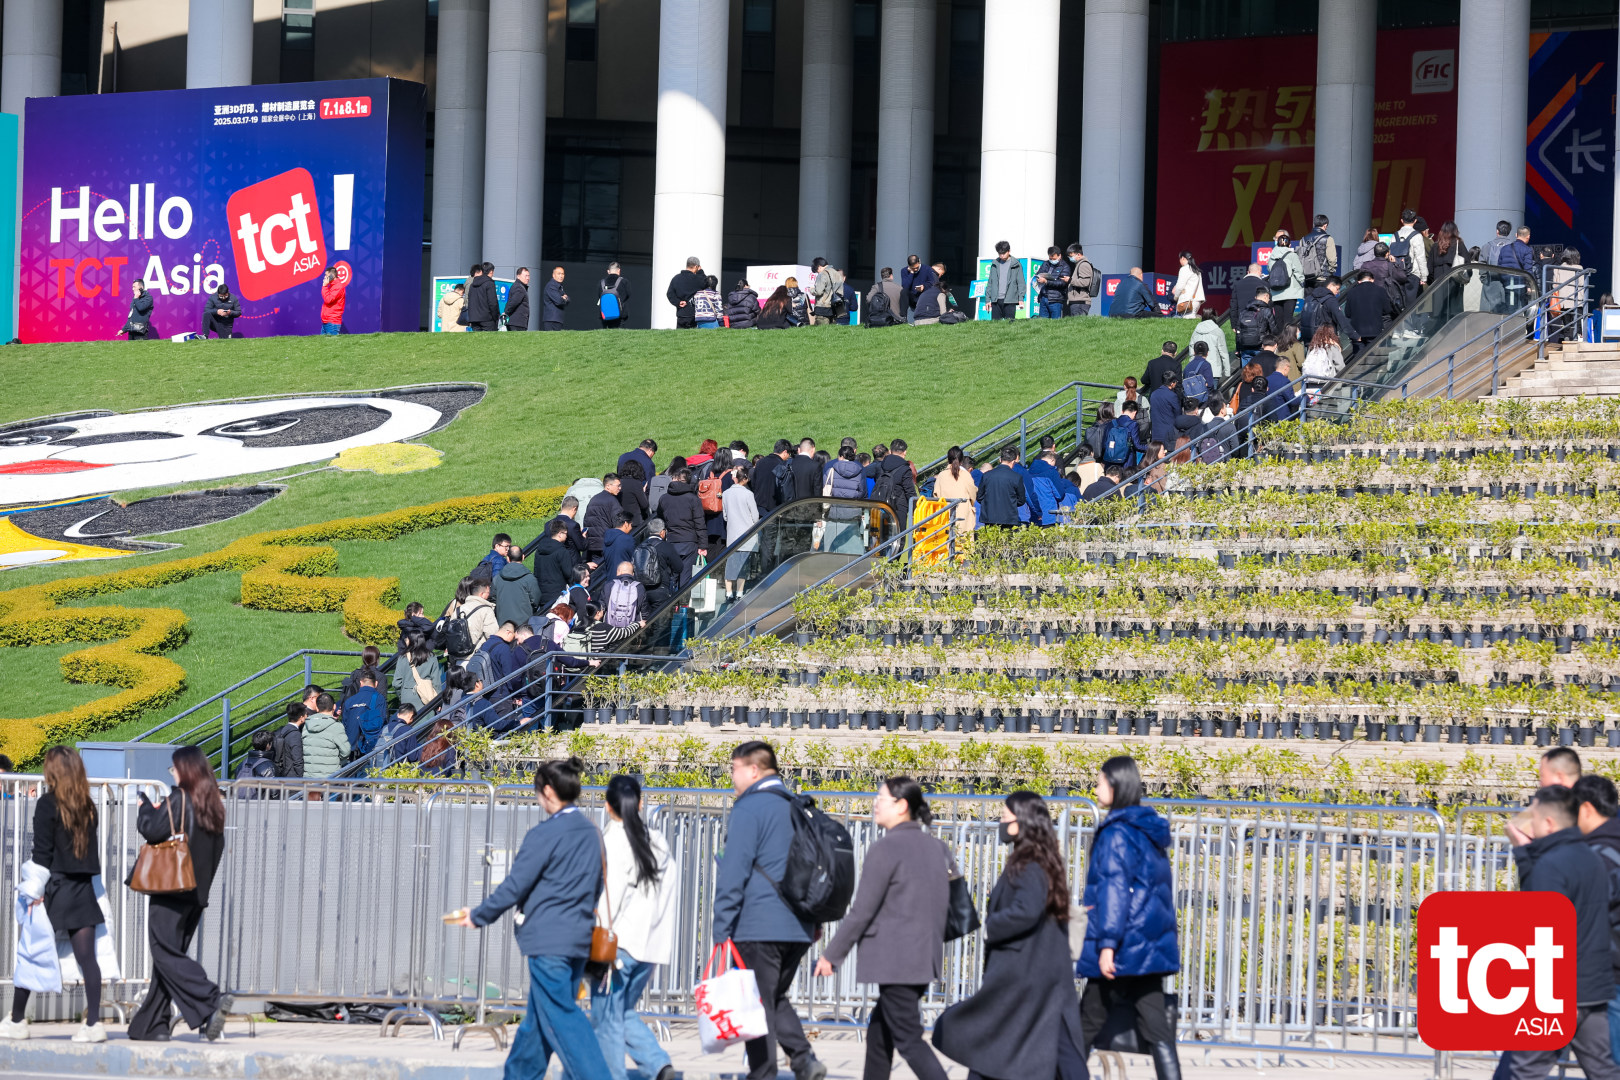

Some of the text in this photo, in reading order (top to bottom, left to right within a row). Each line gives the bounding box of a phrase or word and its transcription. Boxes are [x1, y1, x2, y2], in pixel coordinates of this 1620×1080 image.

[1422, 62, 1451, 80] FIC
[1393, 99, 1406, 111] TO
[213, 115, 259, 126] 2025.03.17-19
[50, 183, 193, 243] Hello
[237, 192, 319, 274] tct
[293, 254, 321, 275] ASIA
[50, 253, 225, 299] TCT Asia
[767, 272, 779, 280] FIC
